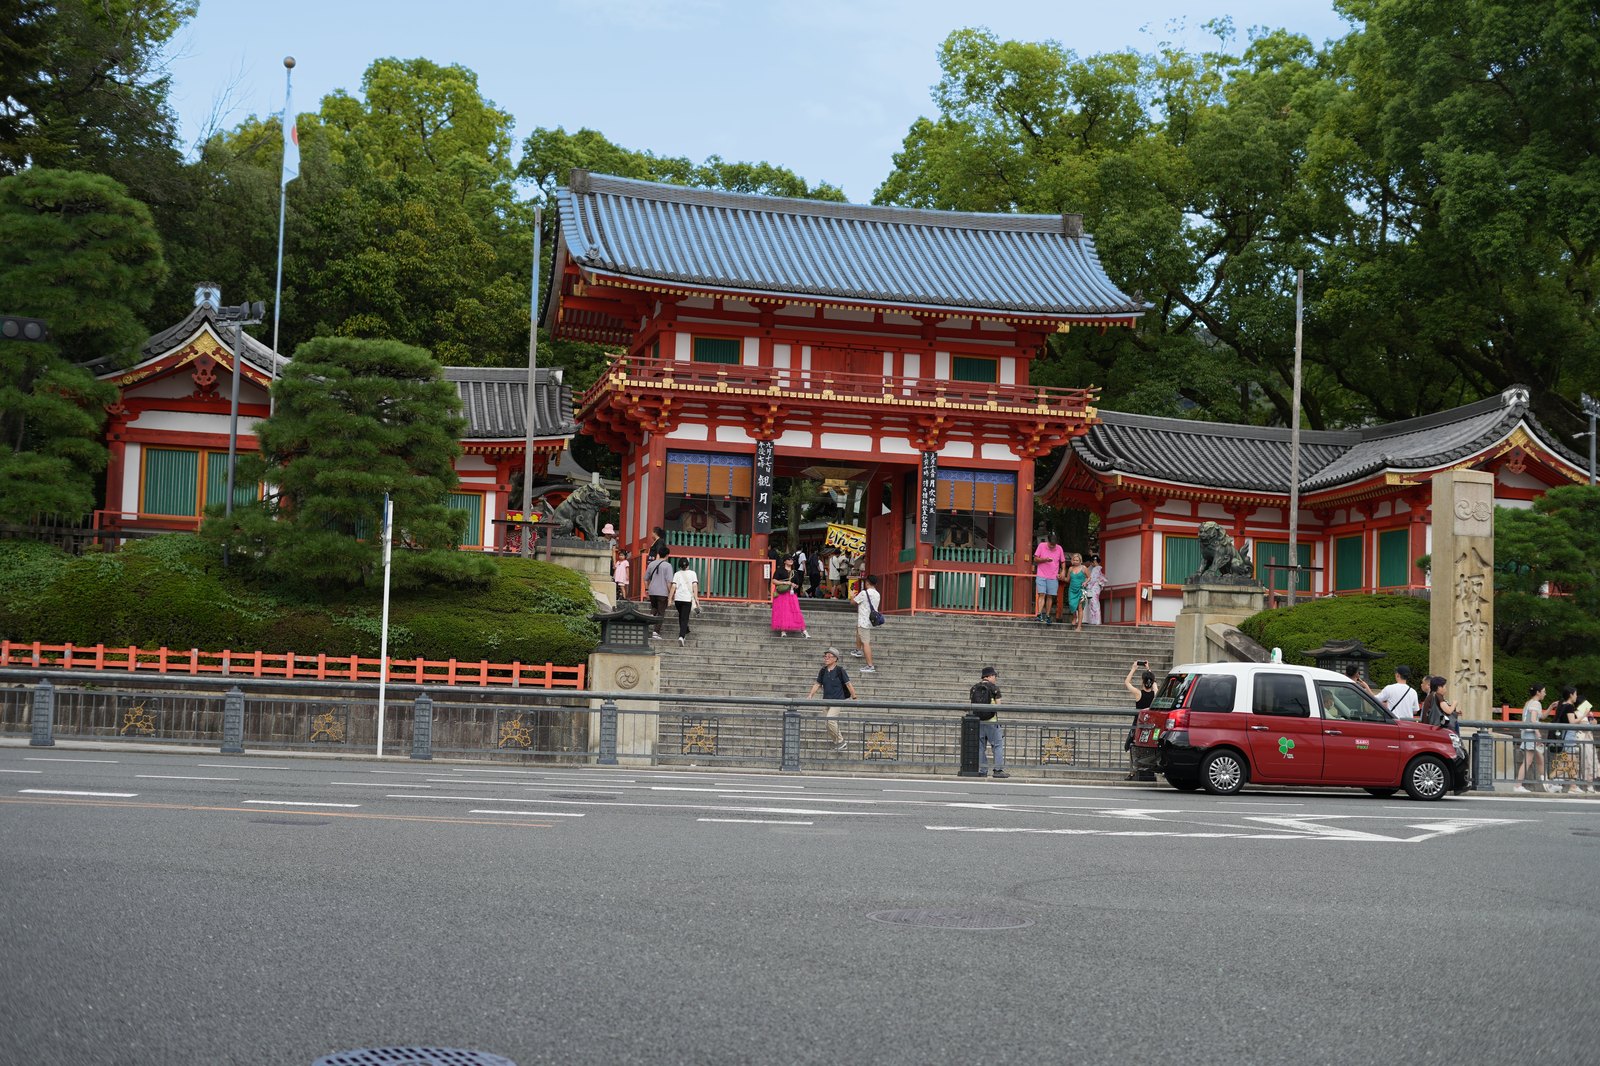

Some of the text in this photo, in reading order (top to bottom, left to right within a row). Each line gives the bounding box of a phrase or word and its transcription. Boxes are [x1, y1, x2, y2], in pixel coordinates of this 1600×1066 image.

[757, 474, 771, 524] 観月祭
[1454, 546, 1492, 693] 八坂神社
